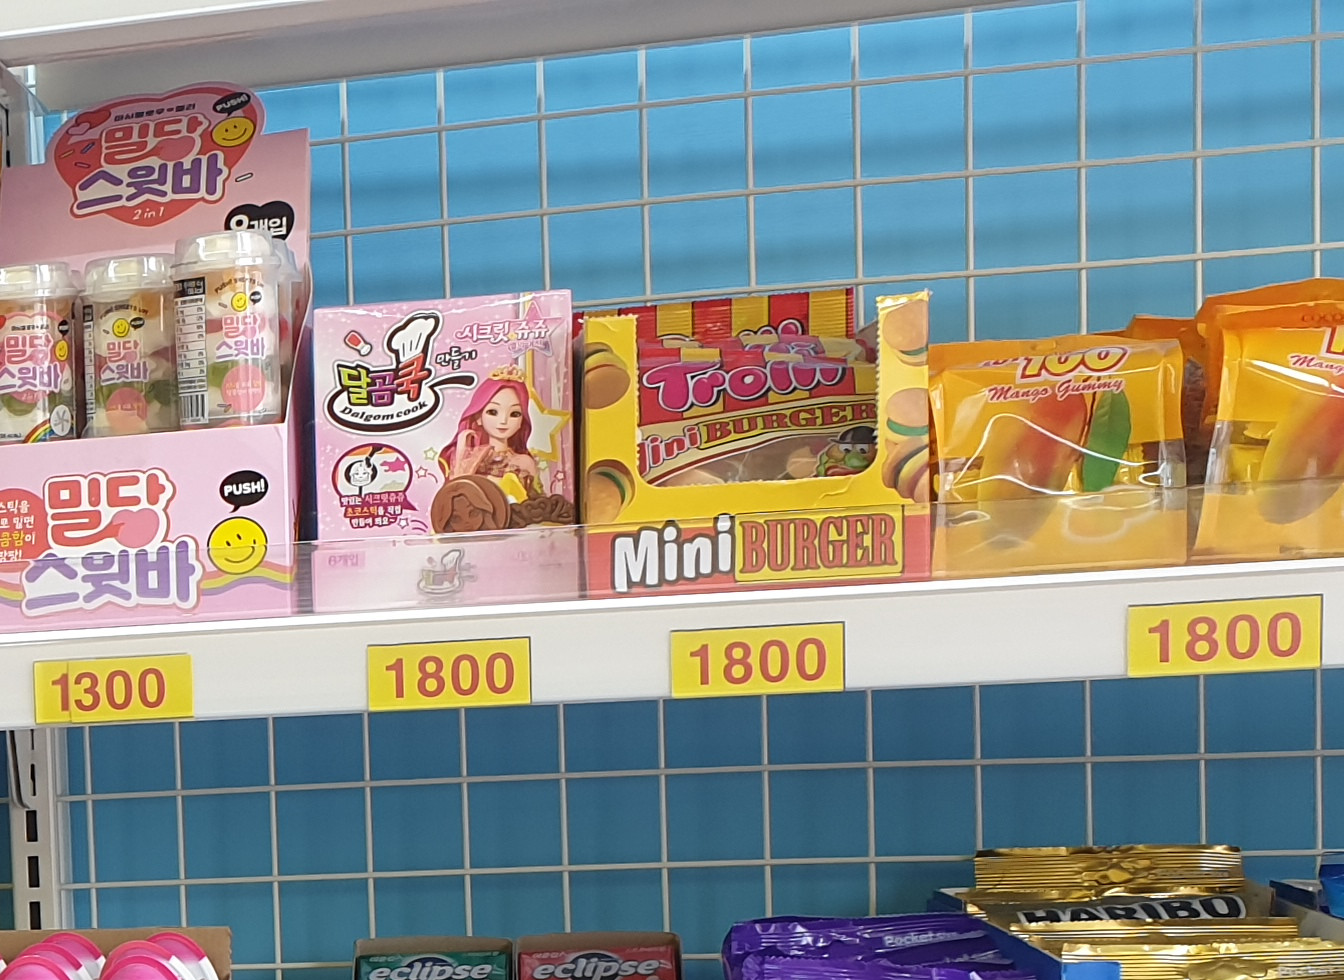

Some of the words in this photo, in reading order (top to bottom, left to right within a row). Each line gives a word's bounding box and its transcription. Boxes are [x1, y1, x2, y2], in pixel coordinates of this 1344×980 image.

[216, 95, 249, 111] PUSH!
[76, 153, 223, 211] 스윗바
[458, 322, 509, 343] 시크릿
[436, 346, 478, 369] 만들기
[987, 383, 1050, 403] Mango
[1057, 378, 1125, 401] Gummy
[703, 402, 878, 444] BURGER
[46, 473, 168, 548] 밀당
[224, 478, 266, 498] PUSH!
[25, 540, 197, 610] 스윗바
[613, 513, 735, 594] Mini
[740, 513, 898, 574] BURGER
[1148, 611, 1302, 664] 1800
[385, 652, 516, 699] 1800
[689, 637, 827, 686] 1800
[51, 667, 167, 714] 1300
[532, 951, 660, 980] eclipse
